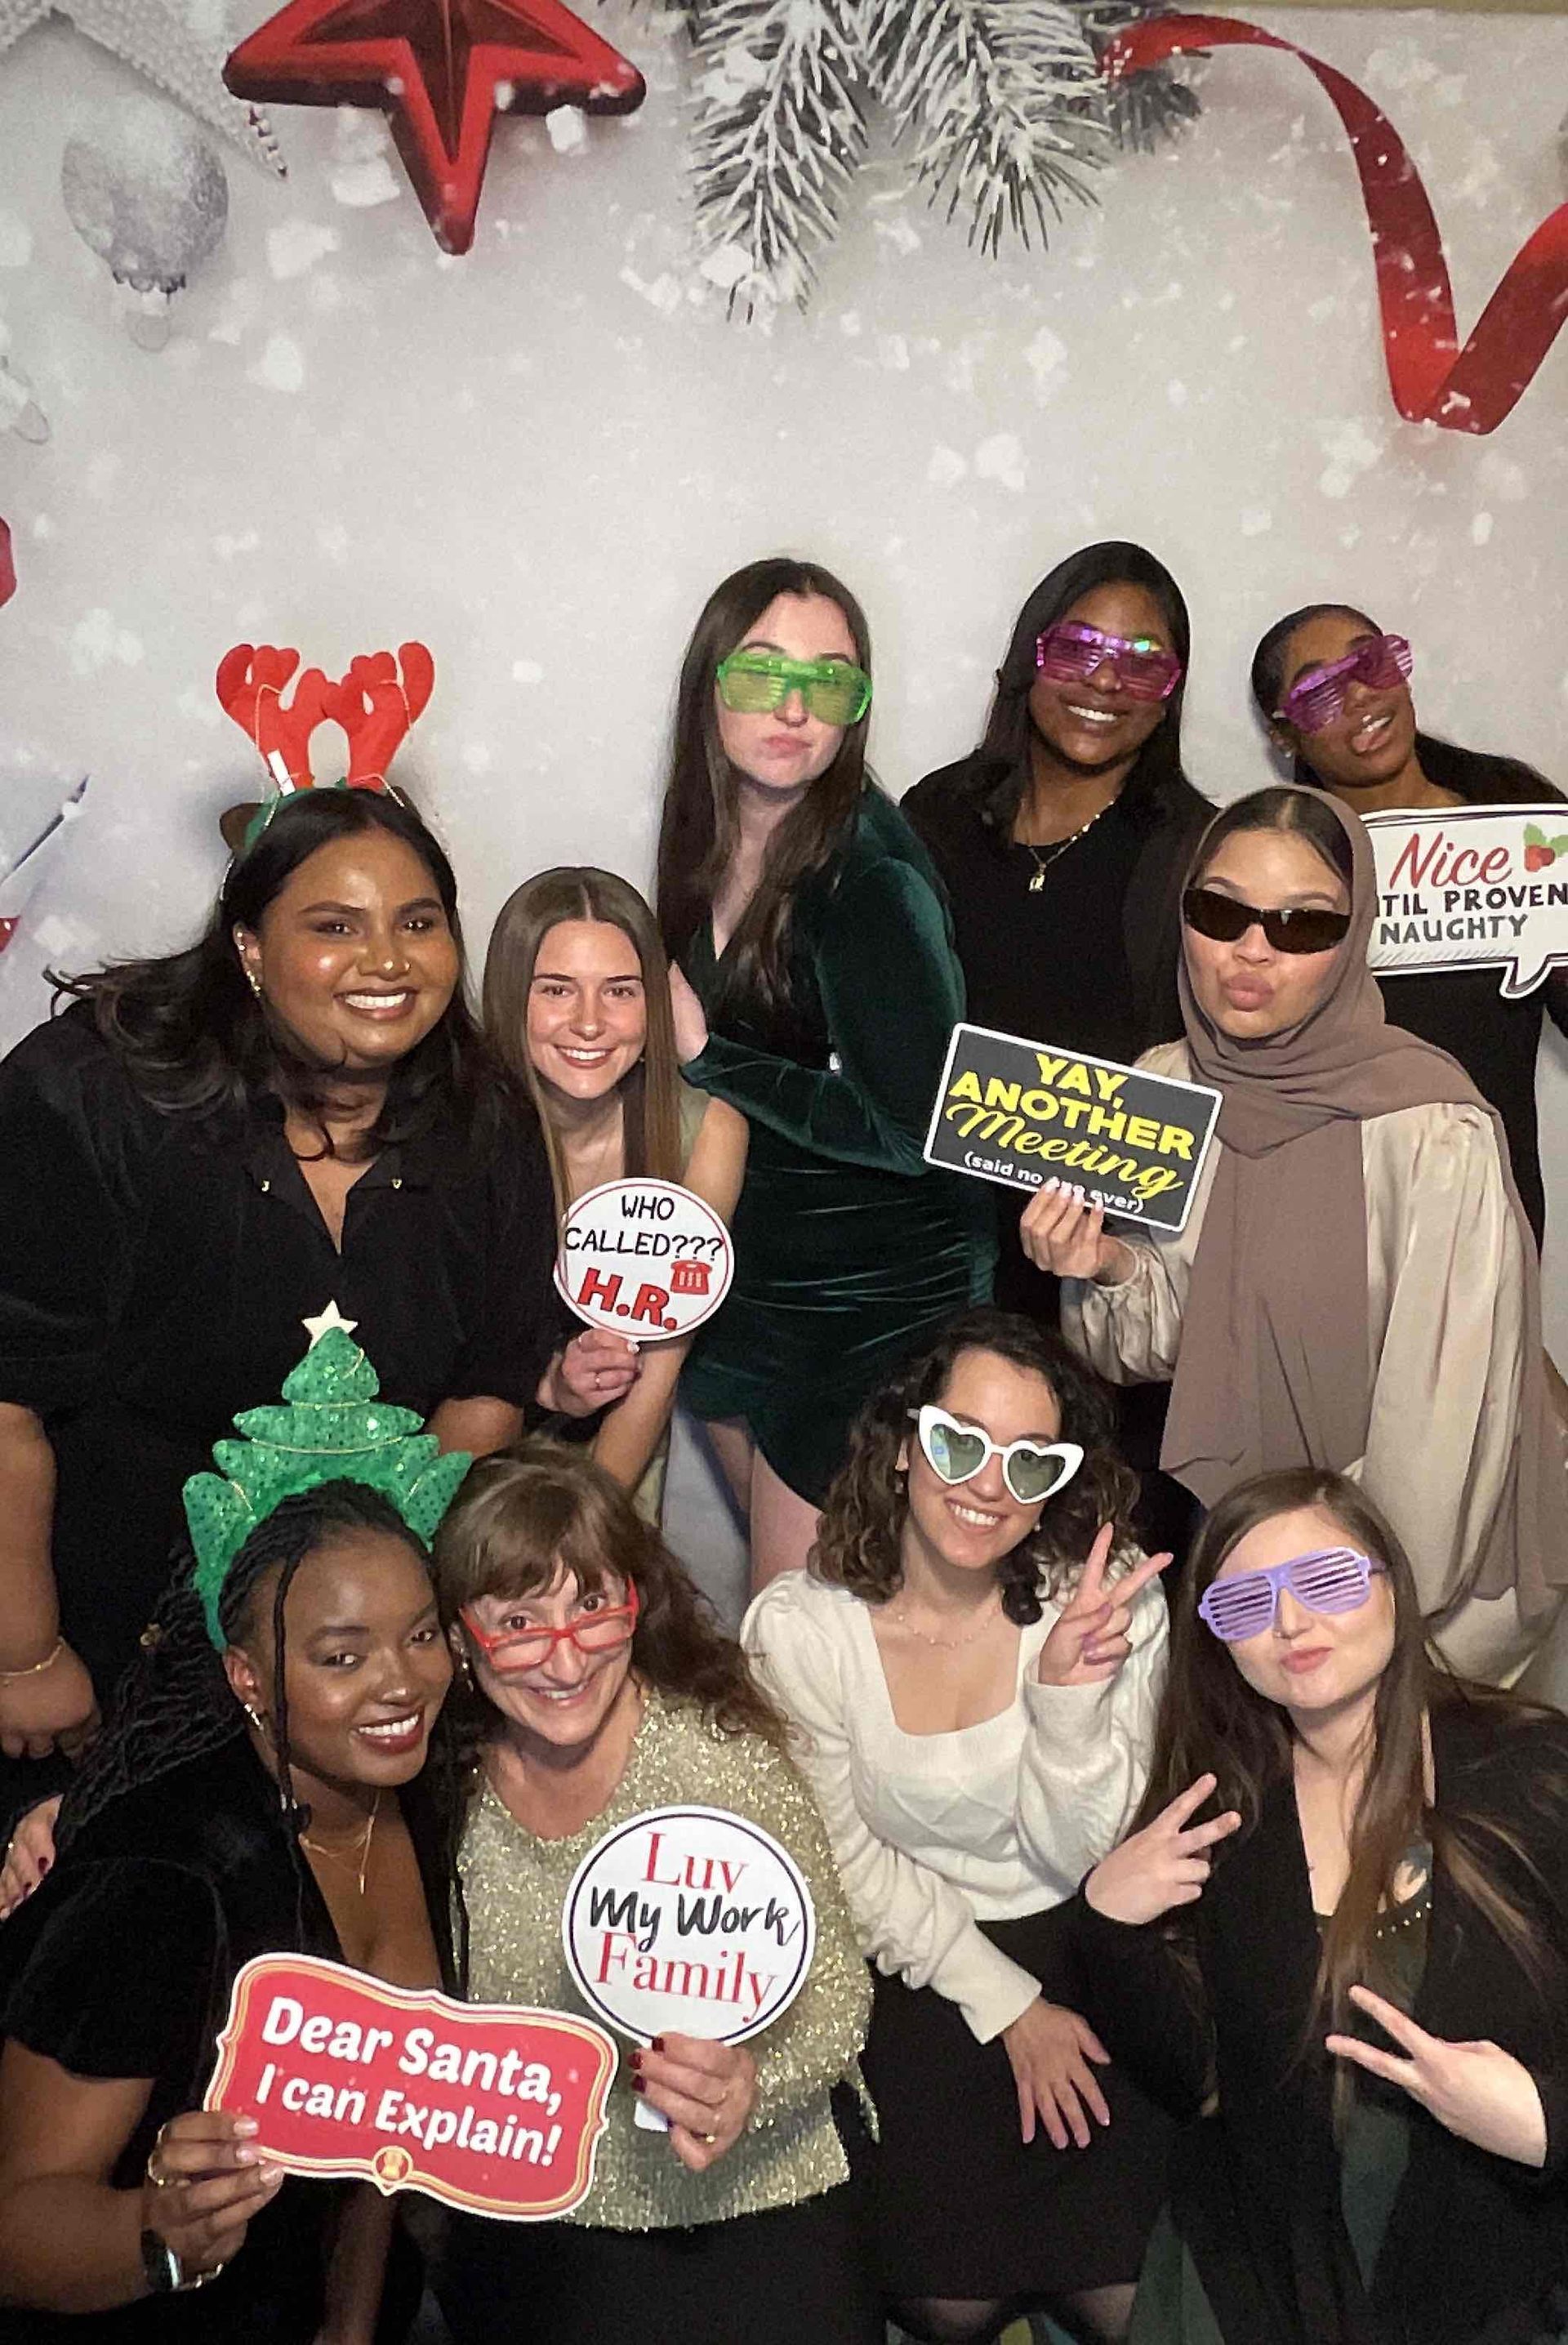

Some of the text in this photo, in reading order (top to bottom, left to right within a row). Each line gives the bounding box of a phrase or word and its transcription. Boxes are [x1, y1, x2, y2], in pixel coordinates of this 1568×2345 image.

[1389, 831, 1512, 889] Nice
[1375, 883, 1568, 917] TIL PROVEN
[1380, 914, 1527, 945] NAUGHTY
[1036, 1052, 1129, 1108] YAY,
[949, 1071, 1196, 1160] ANOTHER
[945, 1103, 1184, 1200] Meeting
[964, 1151, 1144, 1214] (said no ever)
[621, 1195, 675, 1221] WHO
[565, 1227, 725, 1261] CALLED???
[577, 1267, 678, 1331] H.R.
[640, 1831, 749, 1894] Luv
[590, 1886, 801, 1953] My Work
[593, 1930, 777, 2024] Family
[261, 1995, 563, 2117] Dear Santa,
[255, 2063, 563, 2168] I can Explain!
